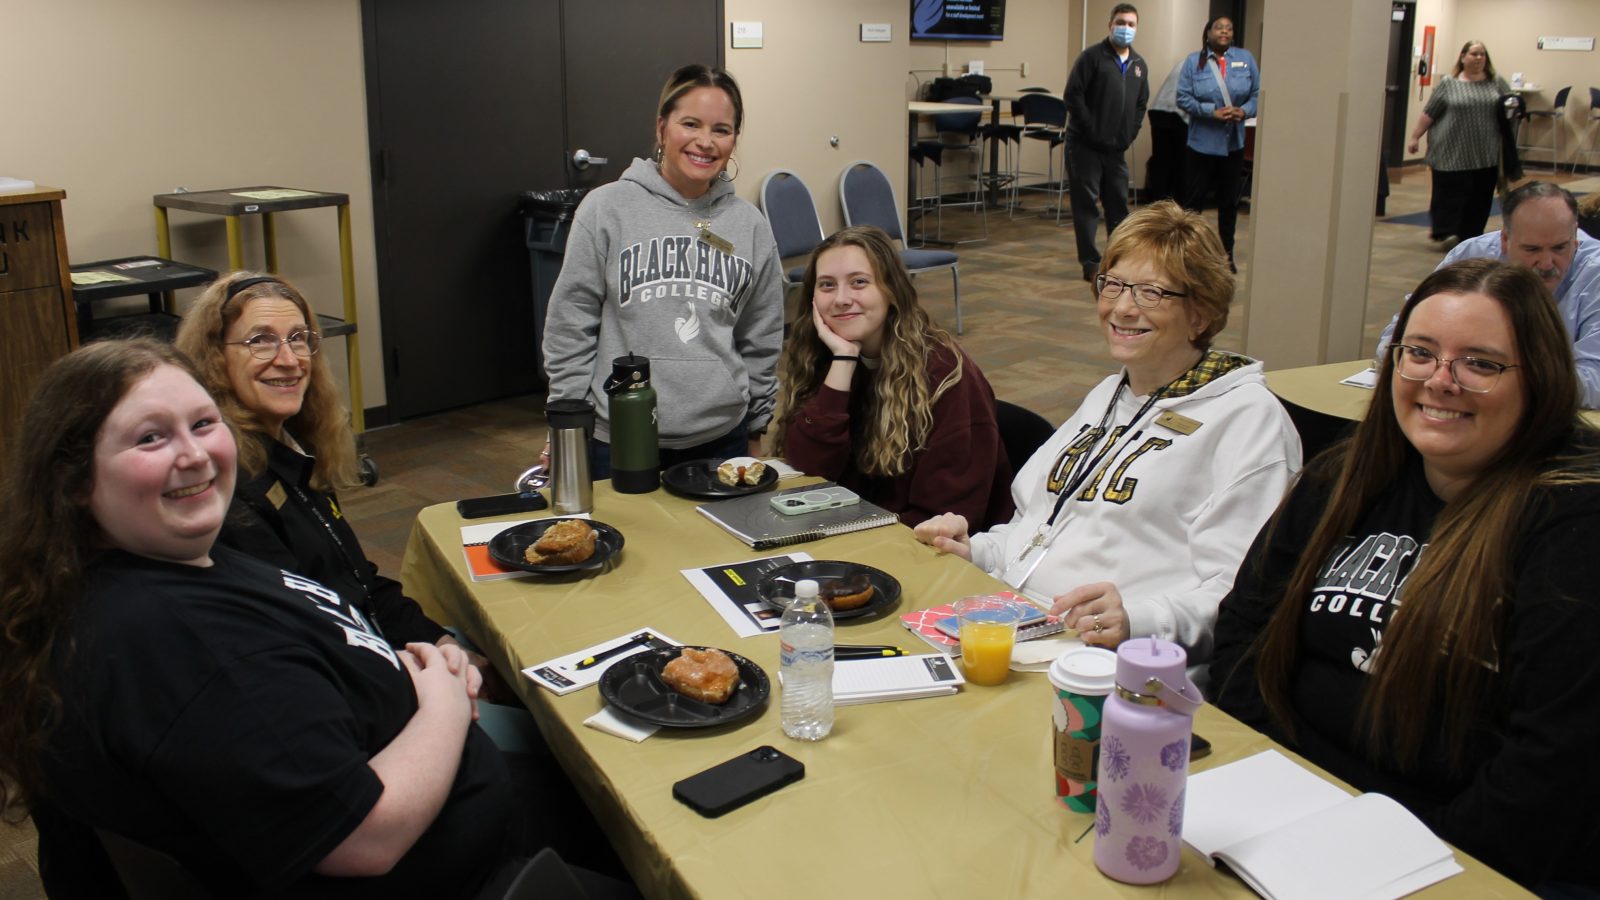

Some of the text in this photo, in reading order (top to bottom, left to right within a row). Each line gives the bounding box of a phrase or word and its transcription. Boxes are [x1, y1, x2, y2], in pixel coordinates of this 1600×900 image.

[619, 236, 692, 308] BLACK
[1312, 531, 1419, 601] LACK
[1310, 594, 1384, 623] COLL
